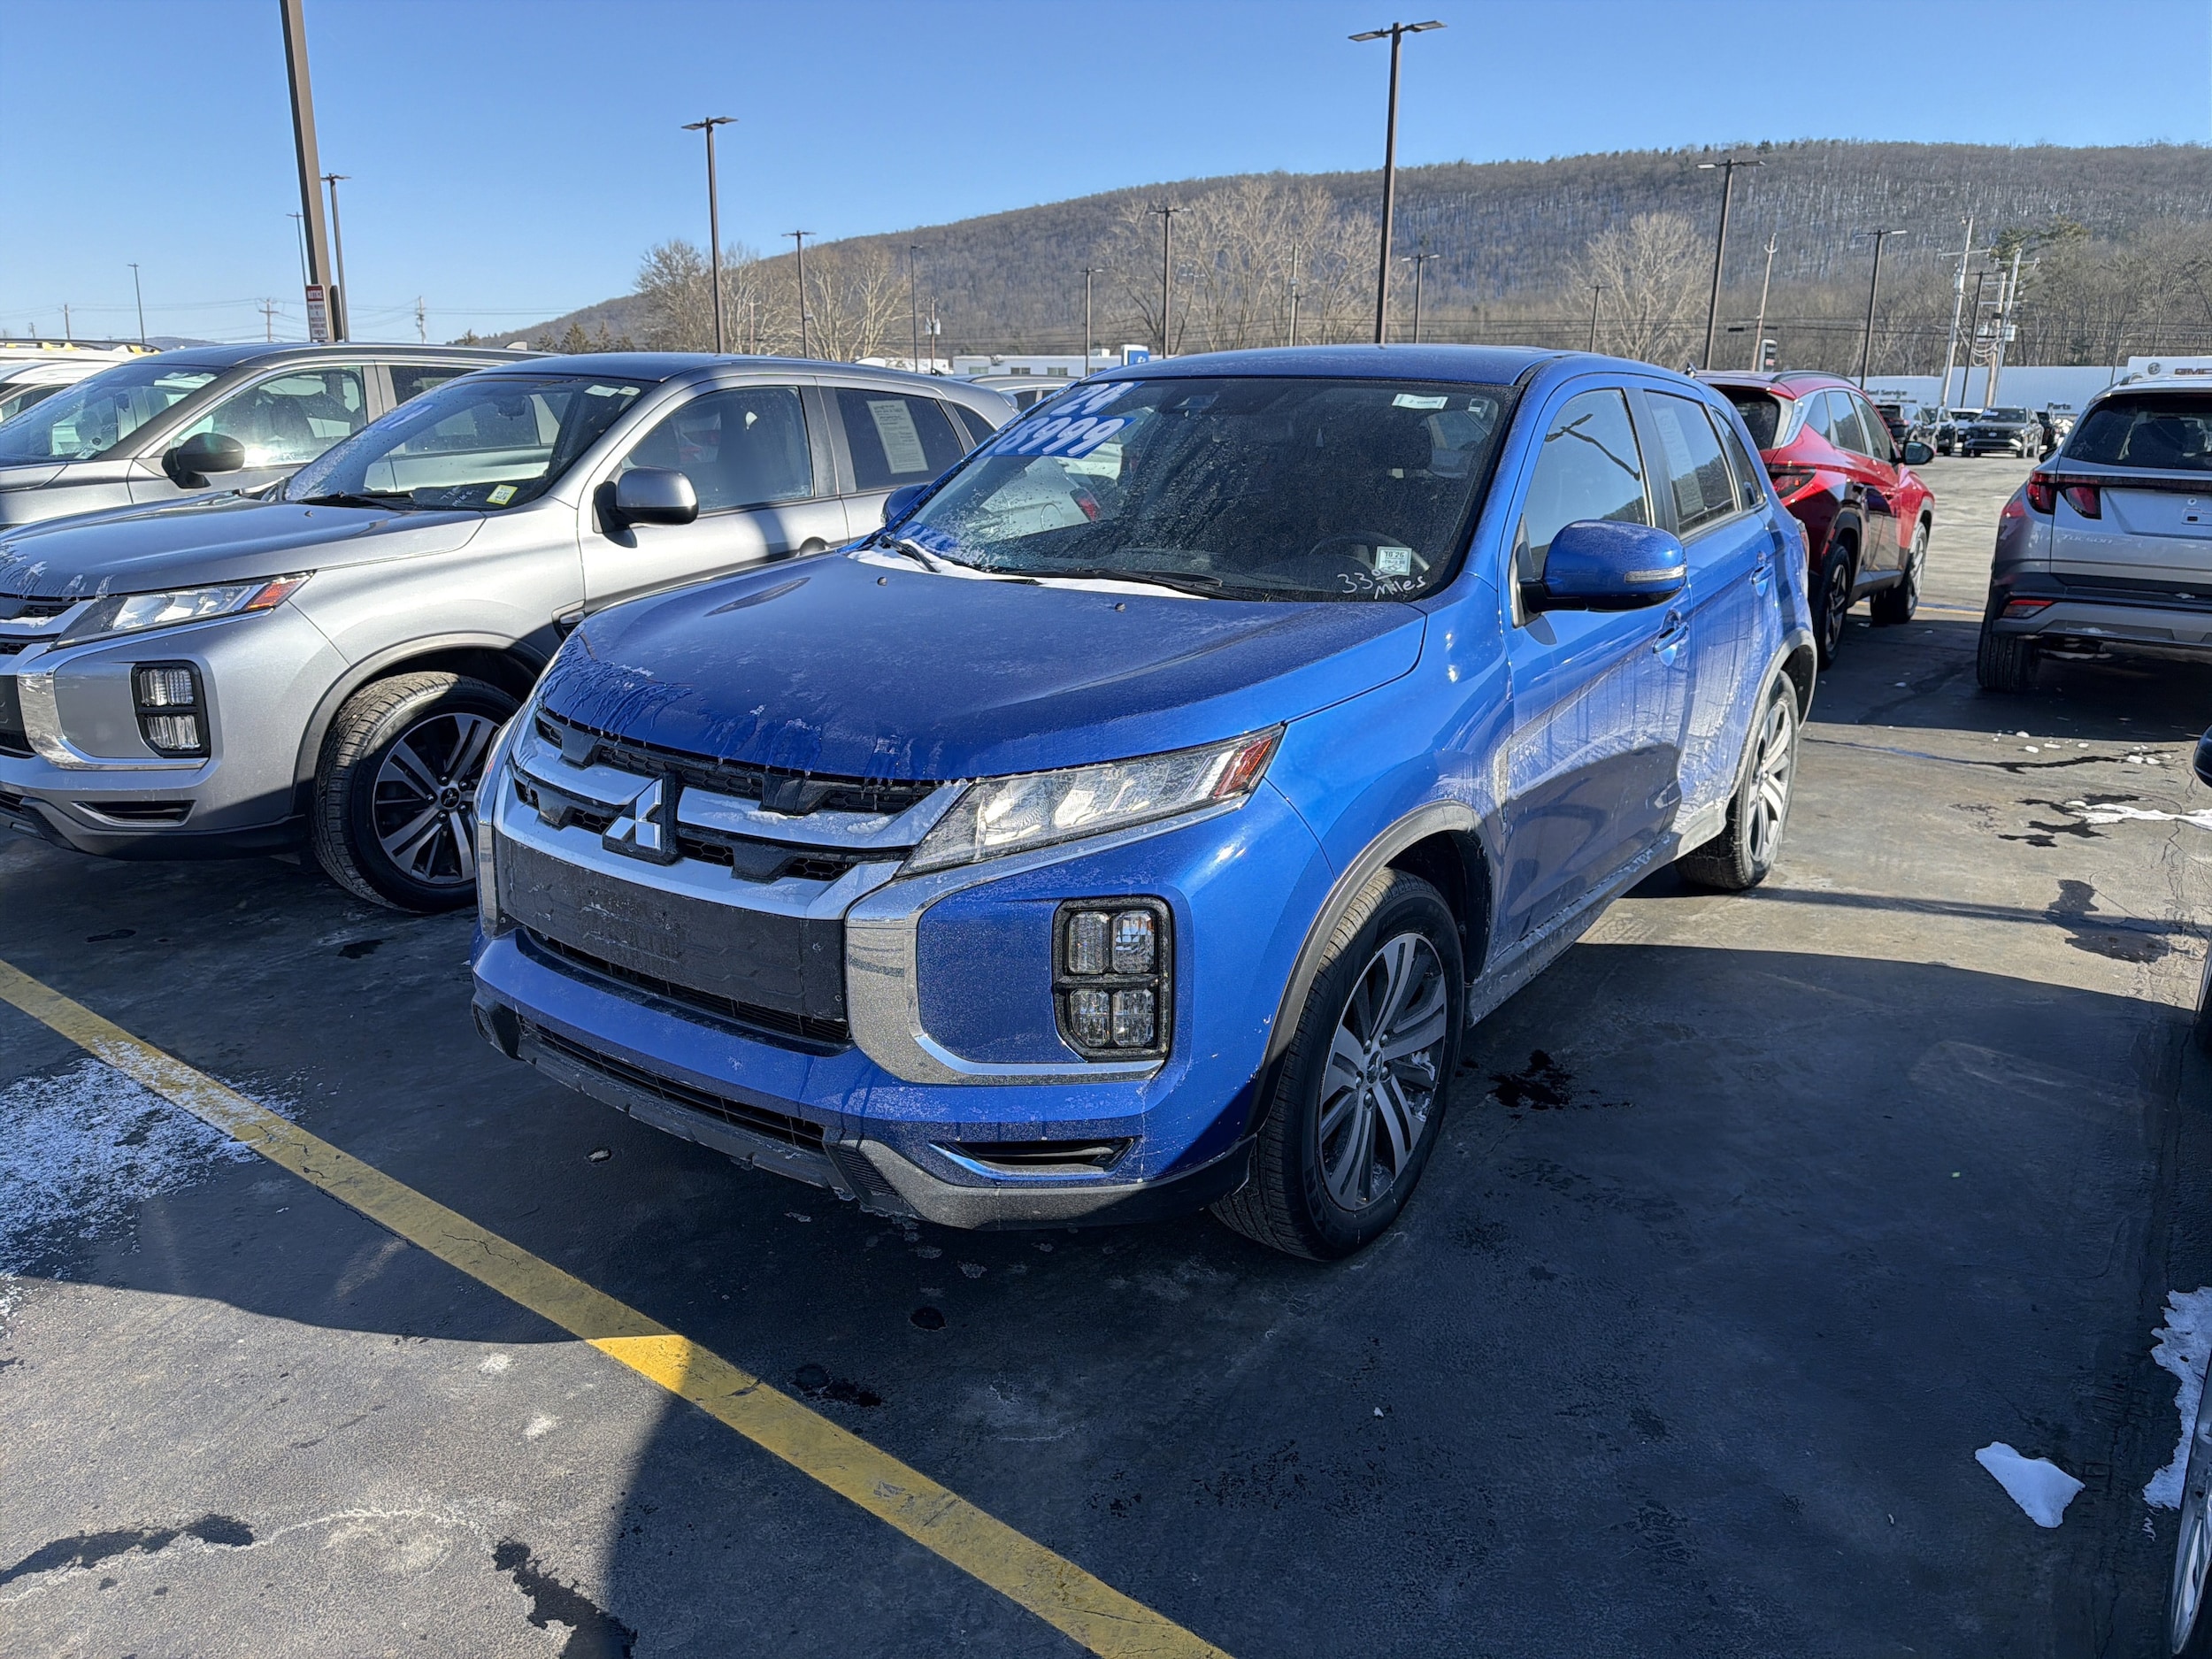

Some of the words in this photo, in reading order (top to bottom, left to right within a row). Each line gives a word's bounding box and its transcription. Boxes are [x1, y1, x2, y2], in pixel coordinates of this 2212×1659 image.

[1050, 381, 1135, 416] 24
[2047, 402, 2071, 411] Parts
[1374, 575, 1426, 600] Miles
